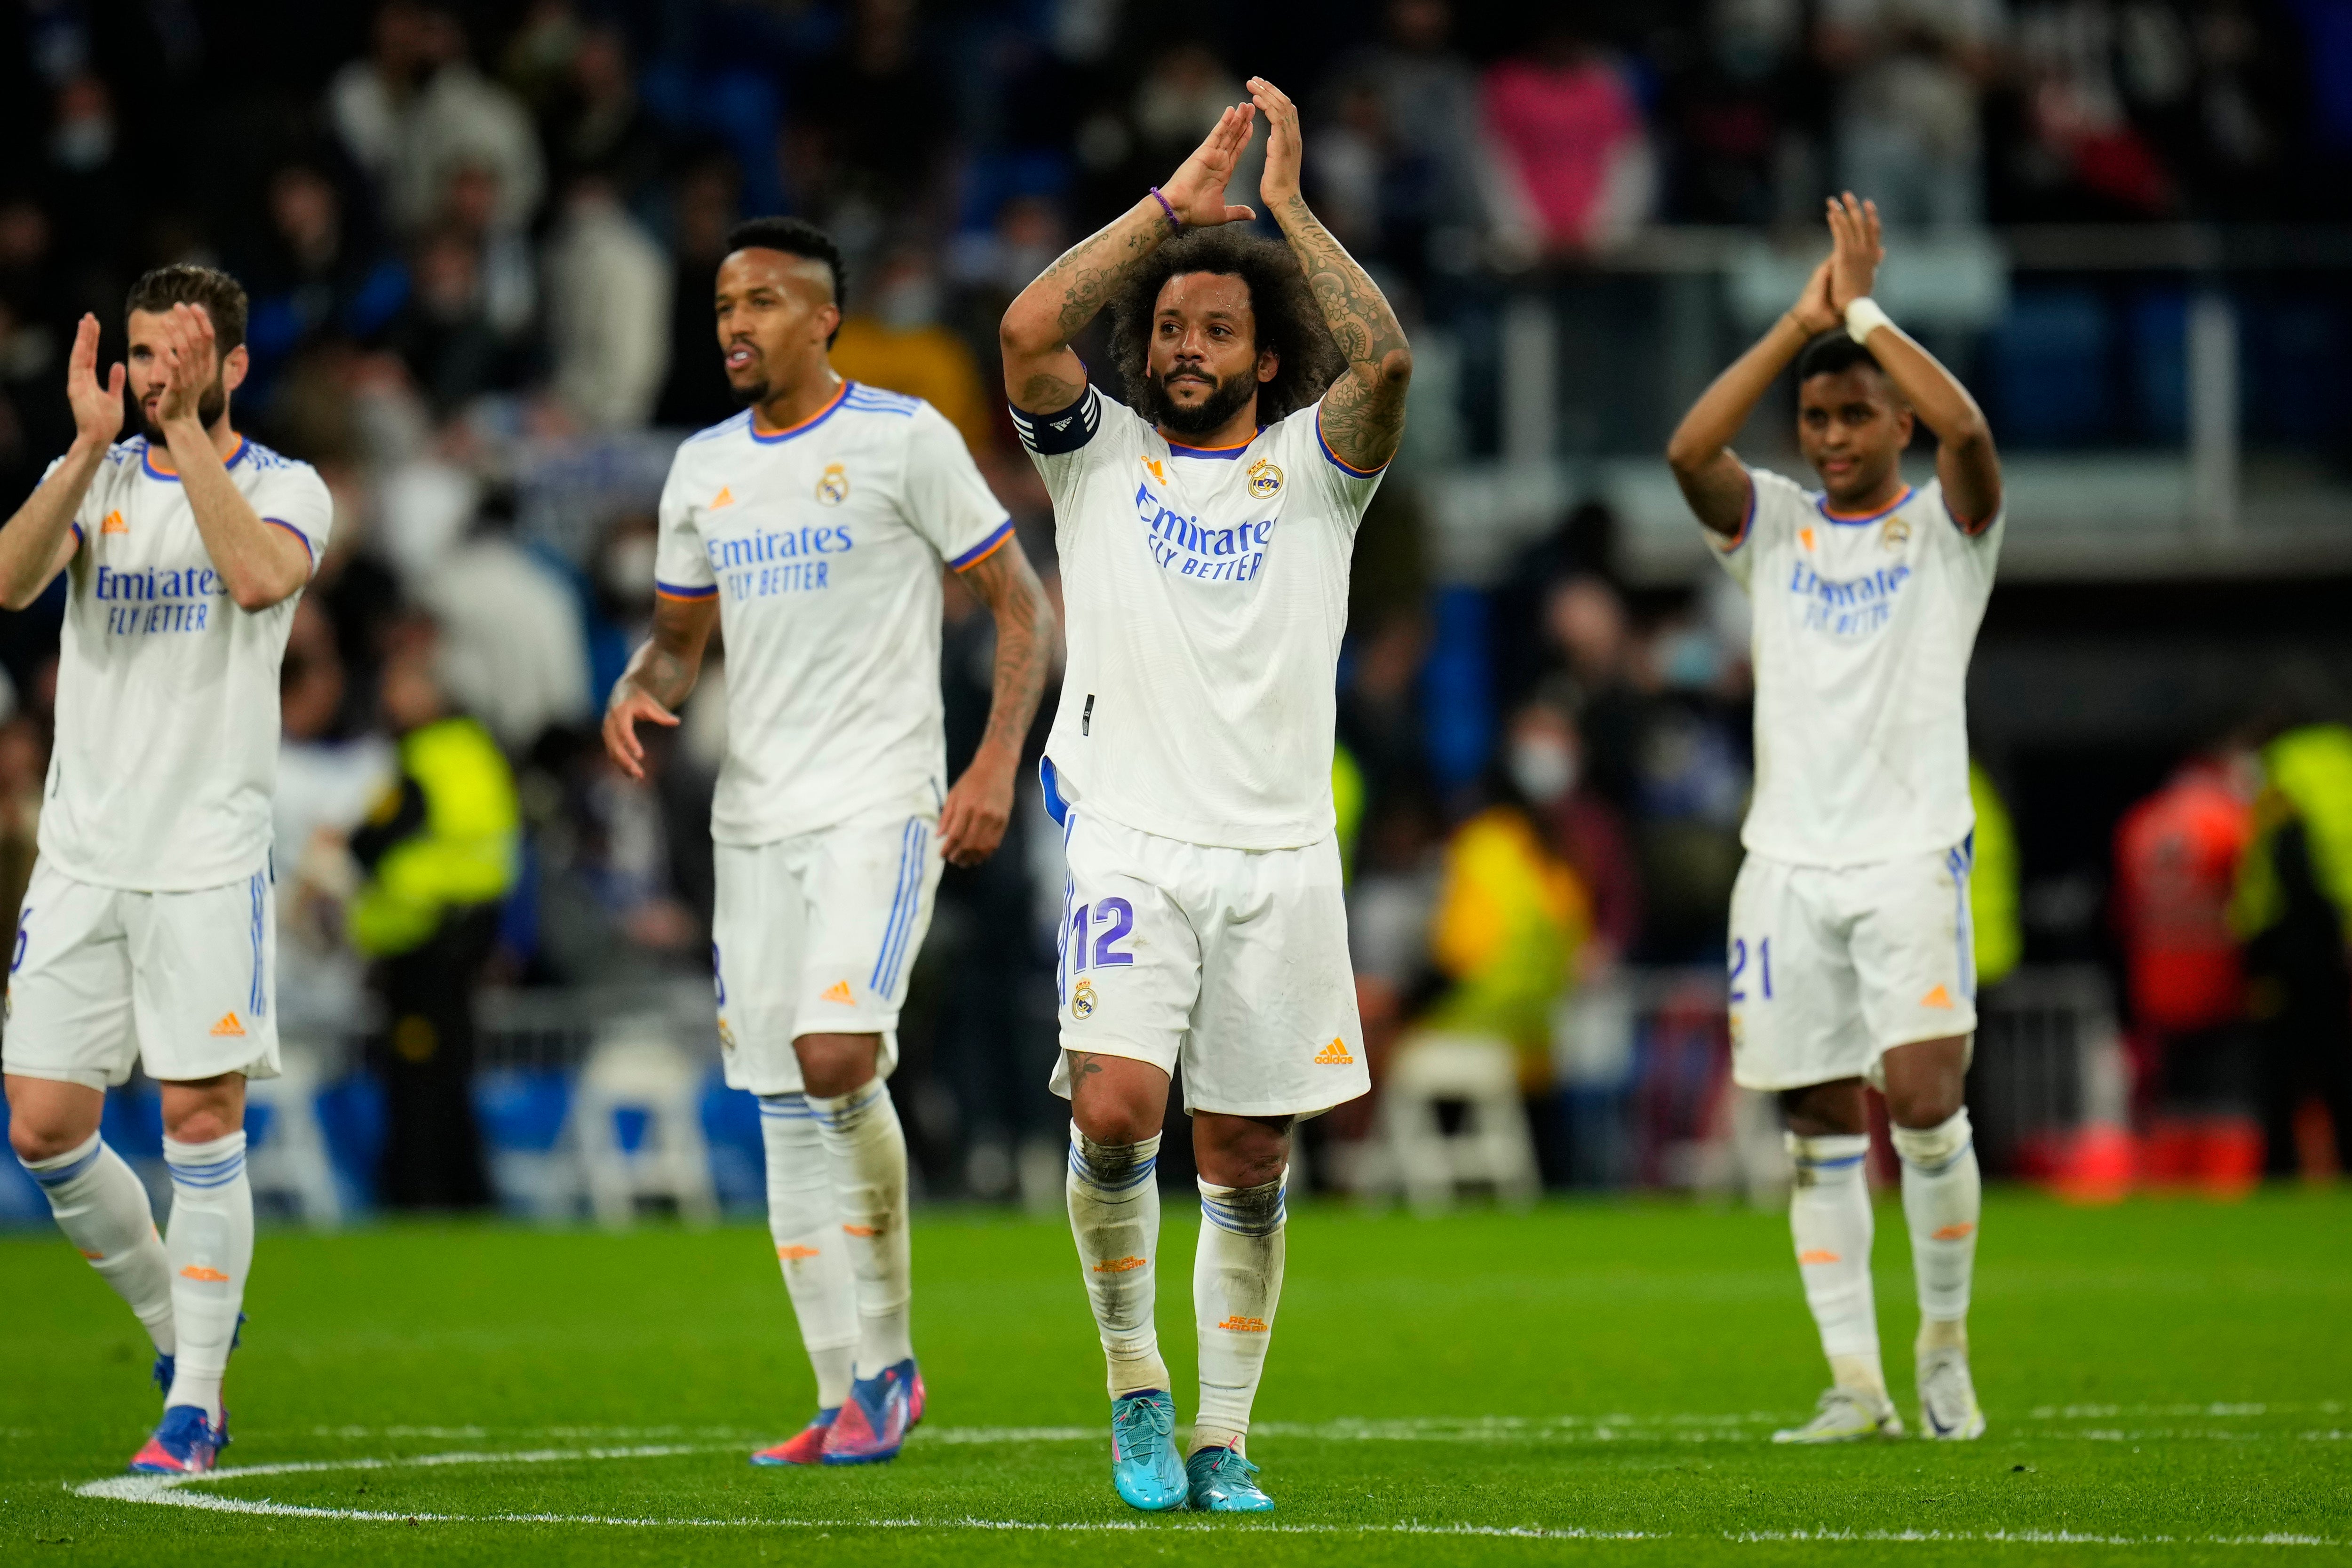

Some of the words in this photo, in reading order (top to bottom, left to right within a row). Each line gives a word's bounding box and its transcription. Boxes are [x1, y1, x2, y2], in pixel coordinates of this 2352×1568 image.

[1136, 482, 1278, 555] Emirate
[707, 525, 852, 572] Emirates
[1149, 533, 1178, 568] FLY
[1181, 552, 1263, 581] BETTER
[96, 565, 229, 601] Emiate
[758, 561, 828, 596] BETTER
[1070, 897, 1134, 975] 12
[1314, 1055, 1354, 1065] adidas
[1229, 1316, 1264, 1325] REAL
